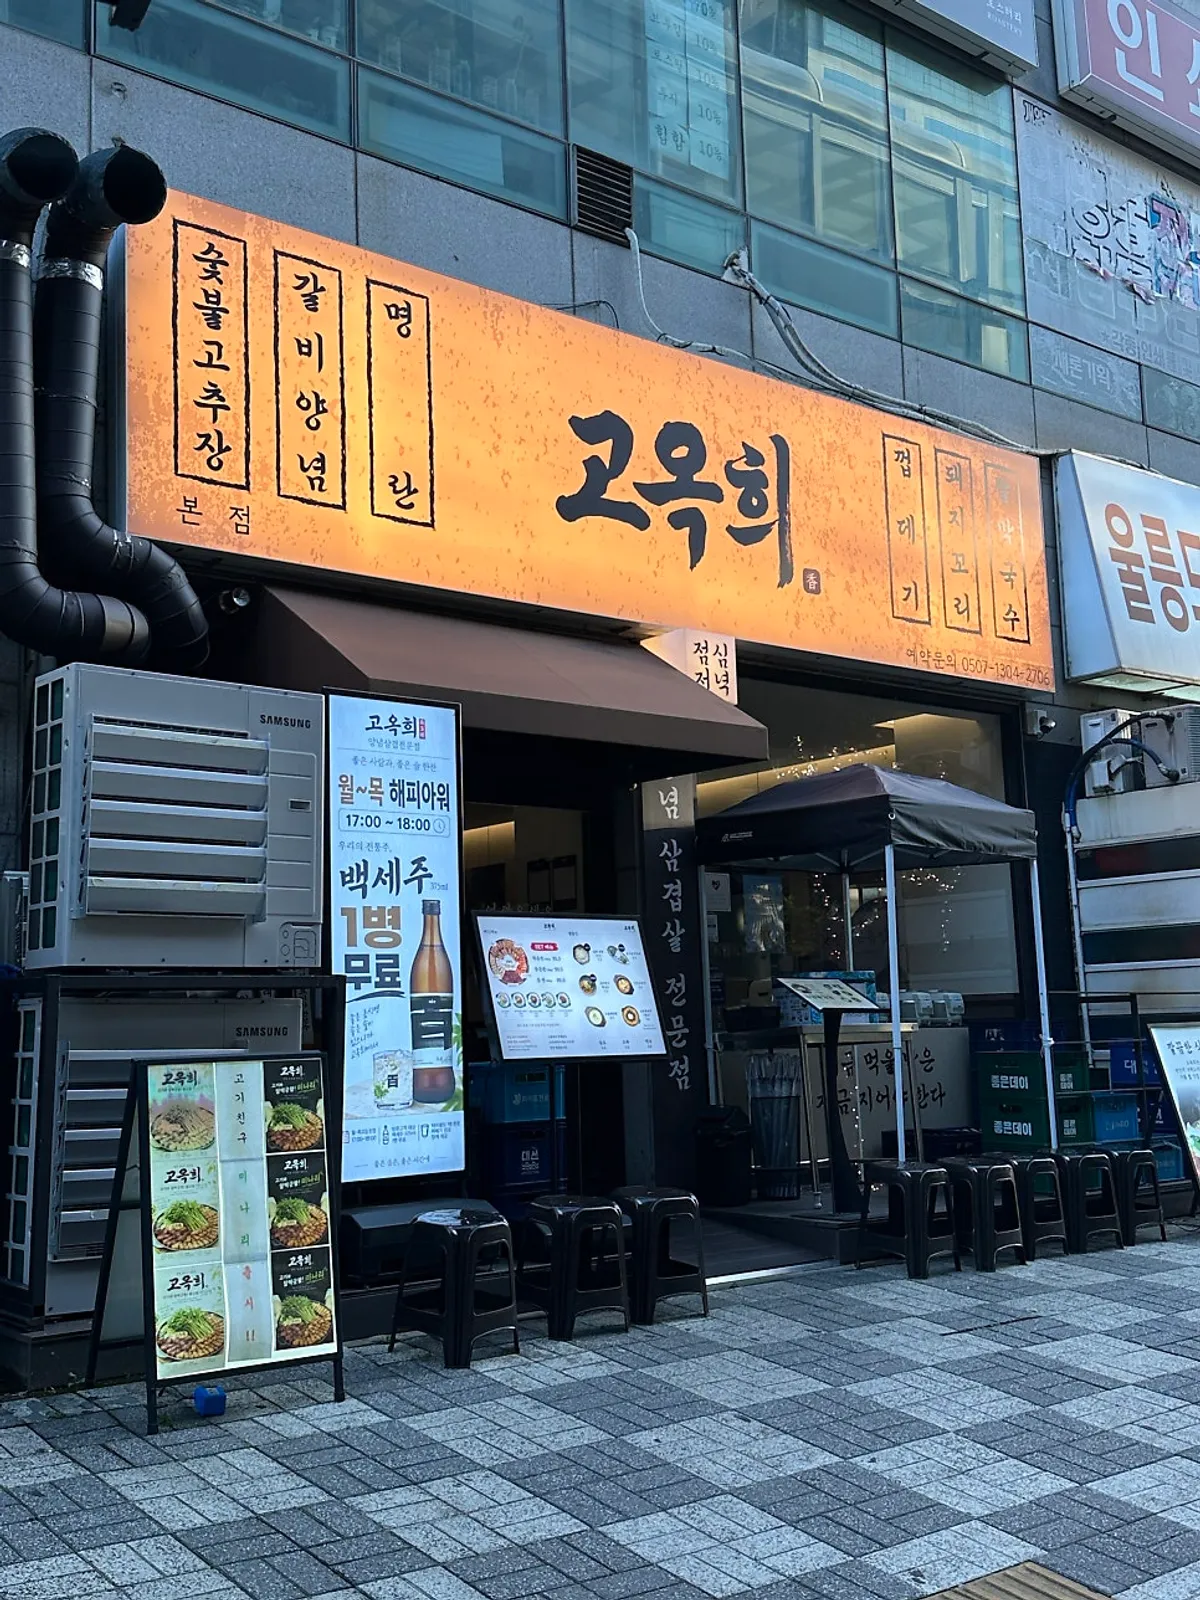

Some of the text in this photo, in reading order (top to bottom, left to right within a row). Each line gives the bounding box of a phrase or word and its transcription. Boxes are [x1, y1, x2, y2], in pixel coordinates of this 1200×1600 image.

[699, 140, 722, 162] 10%
[193, 242, 233, 472] 숯불고추장
[293, 271, 328, 493] 갈비양념
[384, 300, 420, 510] 명란
[555, 409, 794, 589] 고옥희
[894, 447, 919, 611] 껍데기
[945, 462, 970, 623] 돼지꼬리
[907, 647, 1050, 686] 예약문의 0507-1304-2706
[260, 714, 312, 729] SAMSUNG
[365, 713, 418, 738] 고옥희
[338, 773, 450, 812] 월~목 해피아워
[346, 814, 382, 829] 17:00
[397, 817, 431, 831] 18:00
[339, 856, 433, 900] 백세주
[341, 905, 402, 949] 1병
[344, 954, 401, 990] 무료
[236, 1027, 288, 1040] SAMSUNG
[664, 972, 692, 1092] 전문점
[162, 1070, 198, 1086] 고옥희
[279, 1065, 303, 1077] 고옥희
[991, 1074, 1029, 1090] 좋은데이
[234, 1073, 248, 1144] 고기친구
[994, 1121, 1032, 1136] 좋은데이
[164, 1166, 201, 1184] 고옥희
[283, 1158, 307, 1171] 고옥희
[238, 1170, 250, 1246] 미나리
[288, 1254, 312, 1267] 고옥희
[167, 1272, 205, 1292] 고옥희
